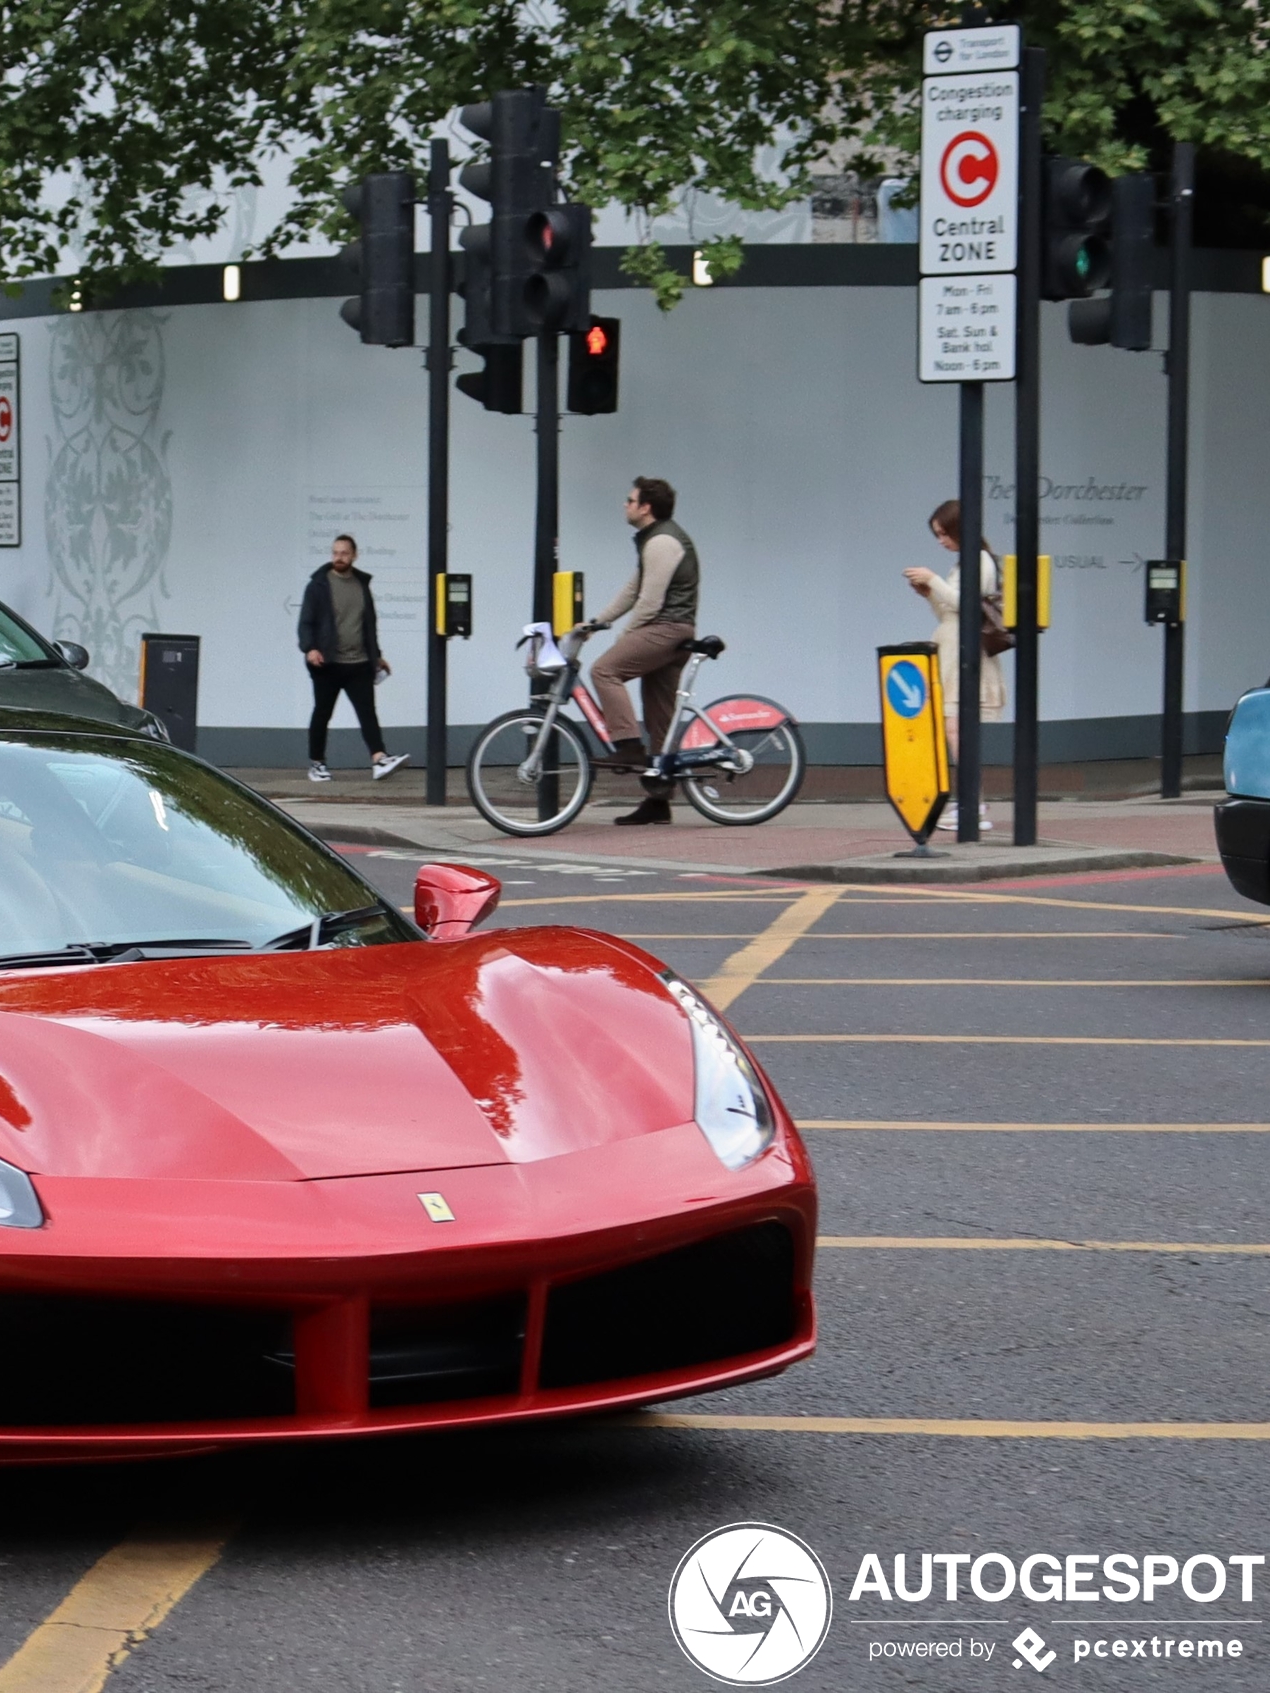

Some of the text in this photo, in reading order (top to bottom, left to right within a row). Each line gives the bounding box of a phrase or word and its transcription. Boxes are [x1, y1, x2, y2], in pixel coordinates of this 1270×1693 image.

[959, 37, 1005, 48] Transport
[975, 50, 1009, 60] London
[927, 82, 1014, 103] Congestion
[936, 104, 1003, 123] charging
[933, 215, 1004, 237] Central
[939, 241, 996, 262] ZONE
[962, 326, 987, 338] Sun
[942, 342, 970, 353] Bank
[1039, 474, 1148, 501] Dorchester
